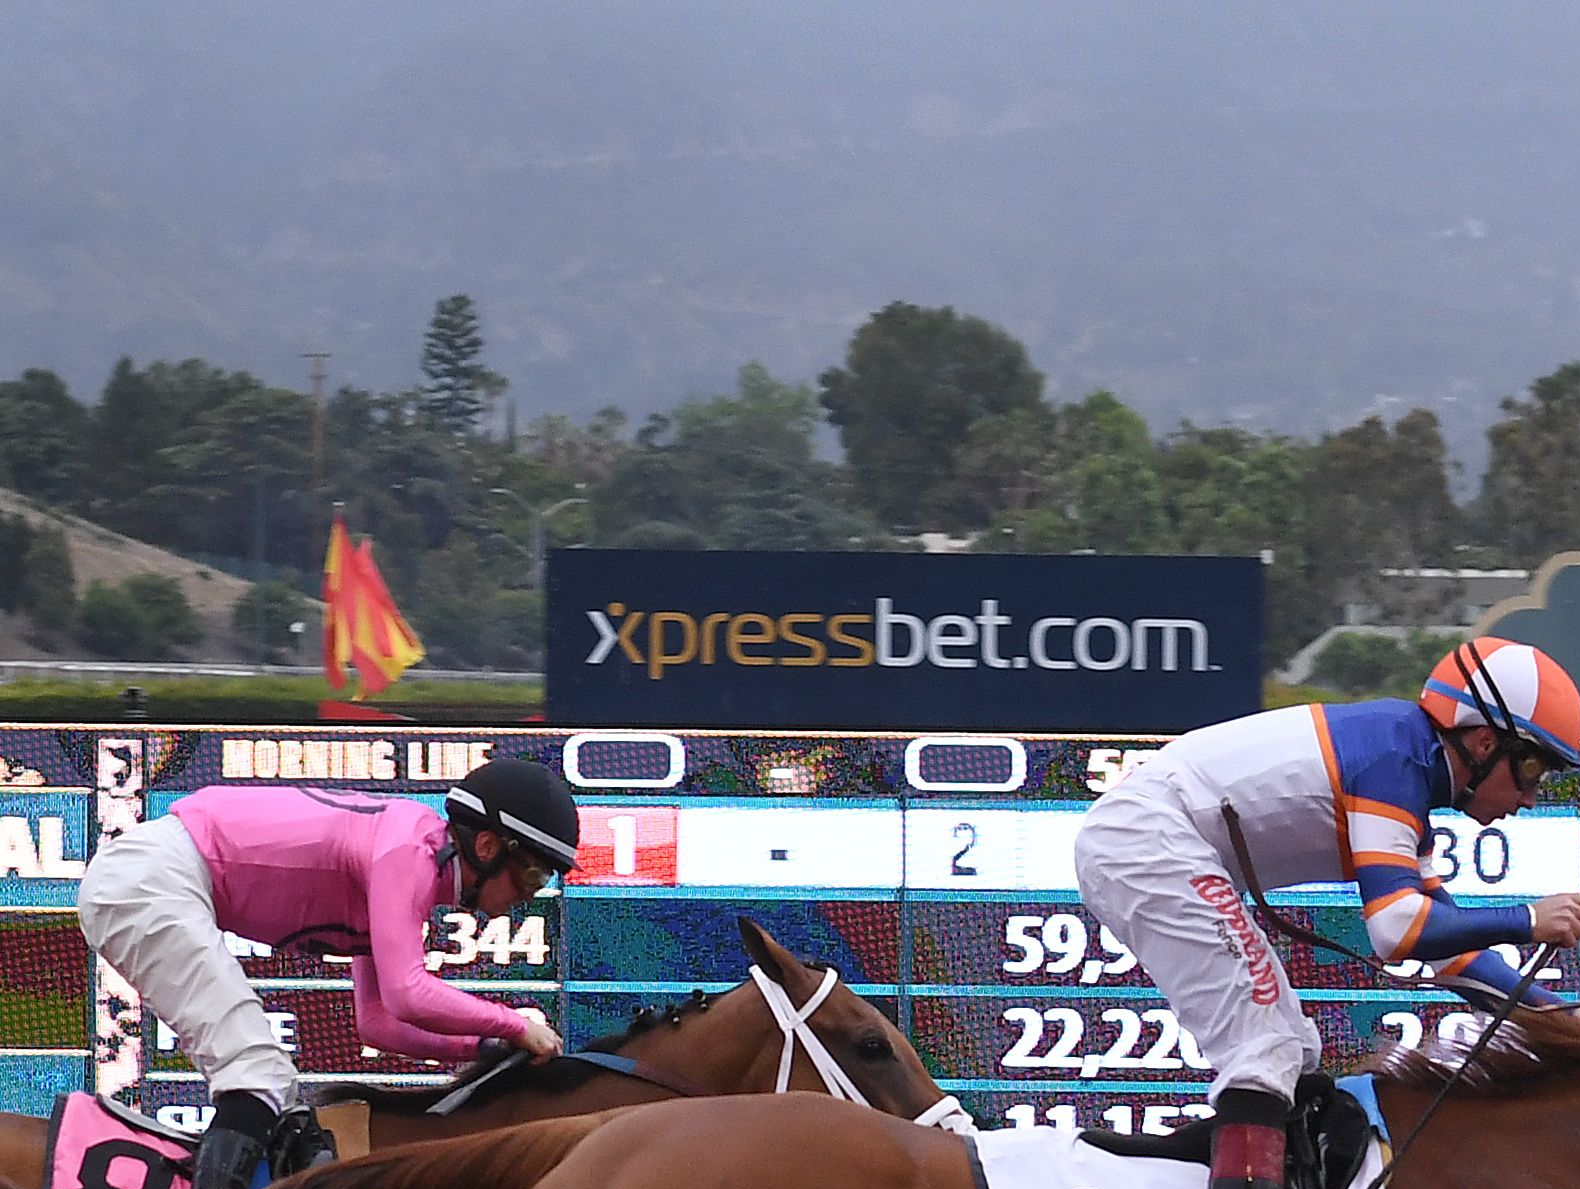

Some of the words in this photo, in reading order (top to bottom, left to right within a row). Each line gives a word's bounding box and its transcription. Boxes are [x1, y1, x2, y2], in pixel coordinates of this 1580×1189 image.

[586, 598, 1212, 680] xpressbet.com
[608, 815, 637, 875] 1
[951, 823, 977, 876] 2
[1432, 827, 1510, 884] 30
[423, 912, 549, 971] ,344
